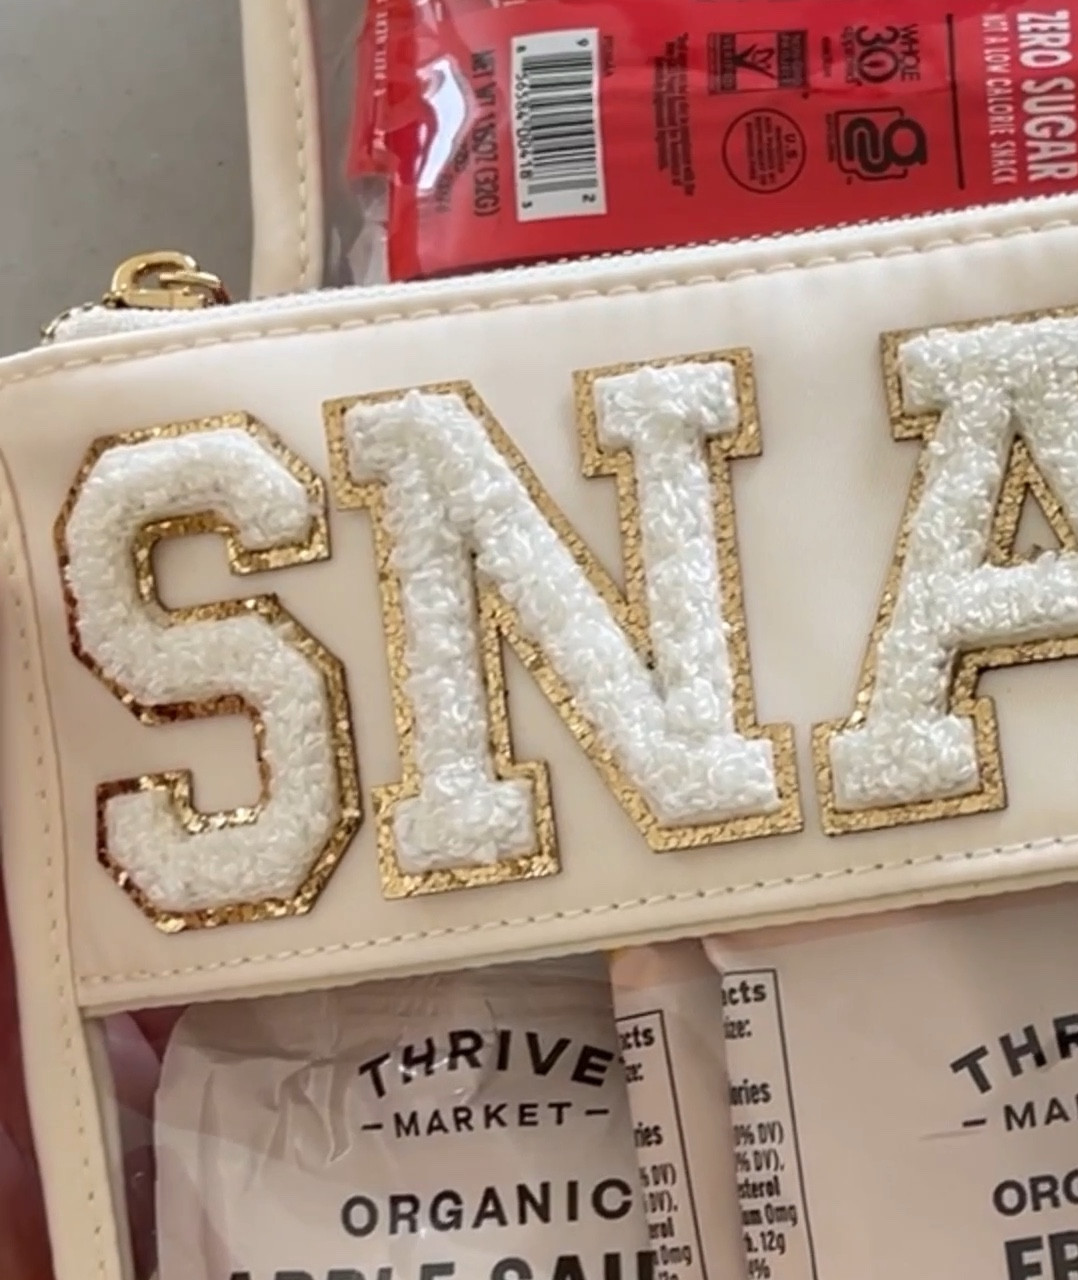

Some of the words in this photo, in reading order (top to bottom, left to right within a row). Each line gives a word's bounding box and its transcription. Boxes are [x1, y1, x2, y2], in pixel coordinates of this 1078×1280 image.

[1016, 9, 1073, 68] ZERO
[985, 77, 1016, 136] CALORIE
[989, 140, 1018, 185] SNACK
[358, 1028, 615, 1100] THRIVE
[394, 1102, 573, 1139] MARKET
[340, 1177, 635, 1238] ORGANIC
